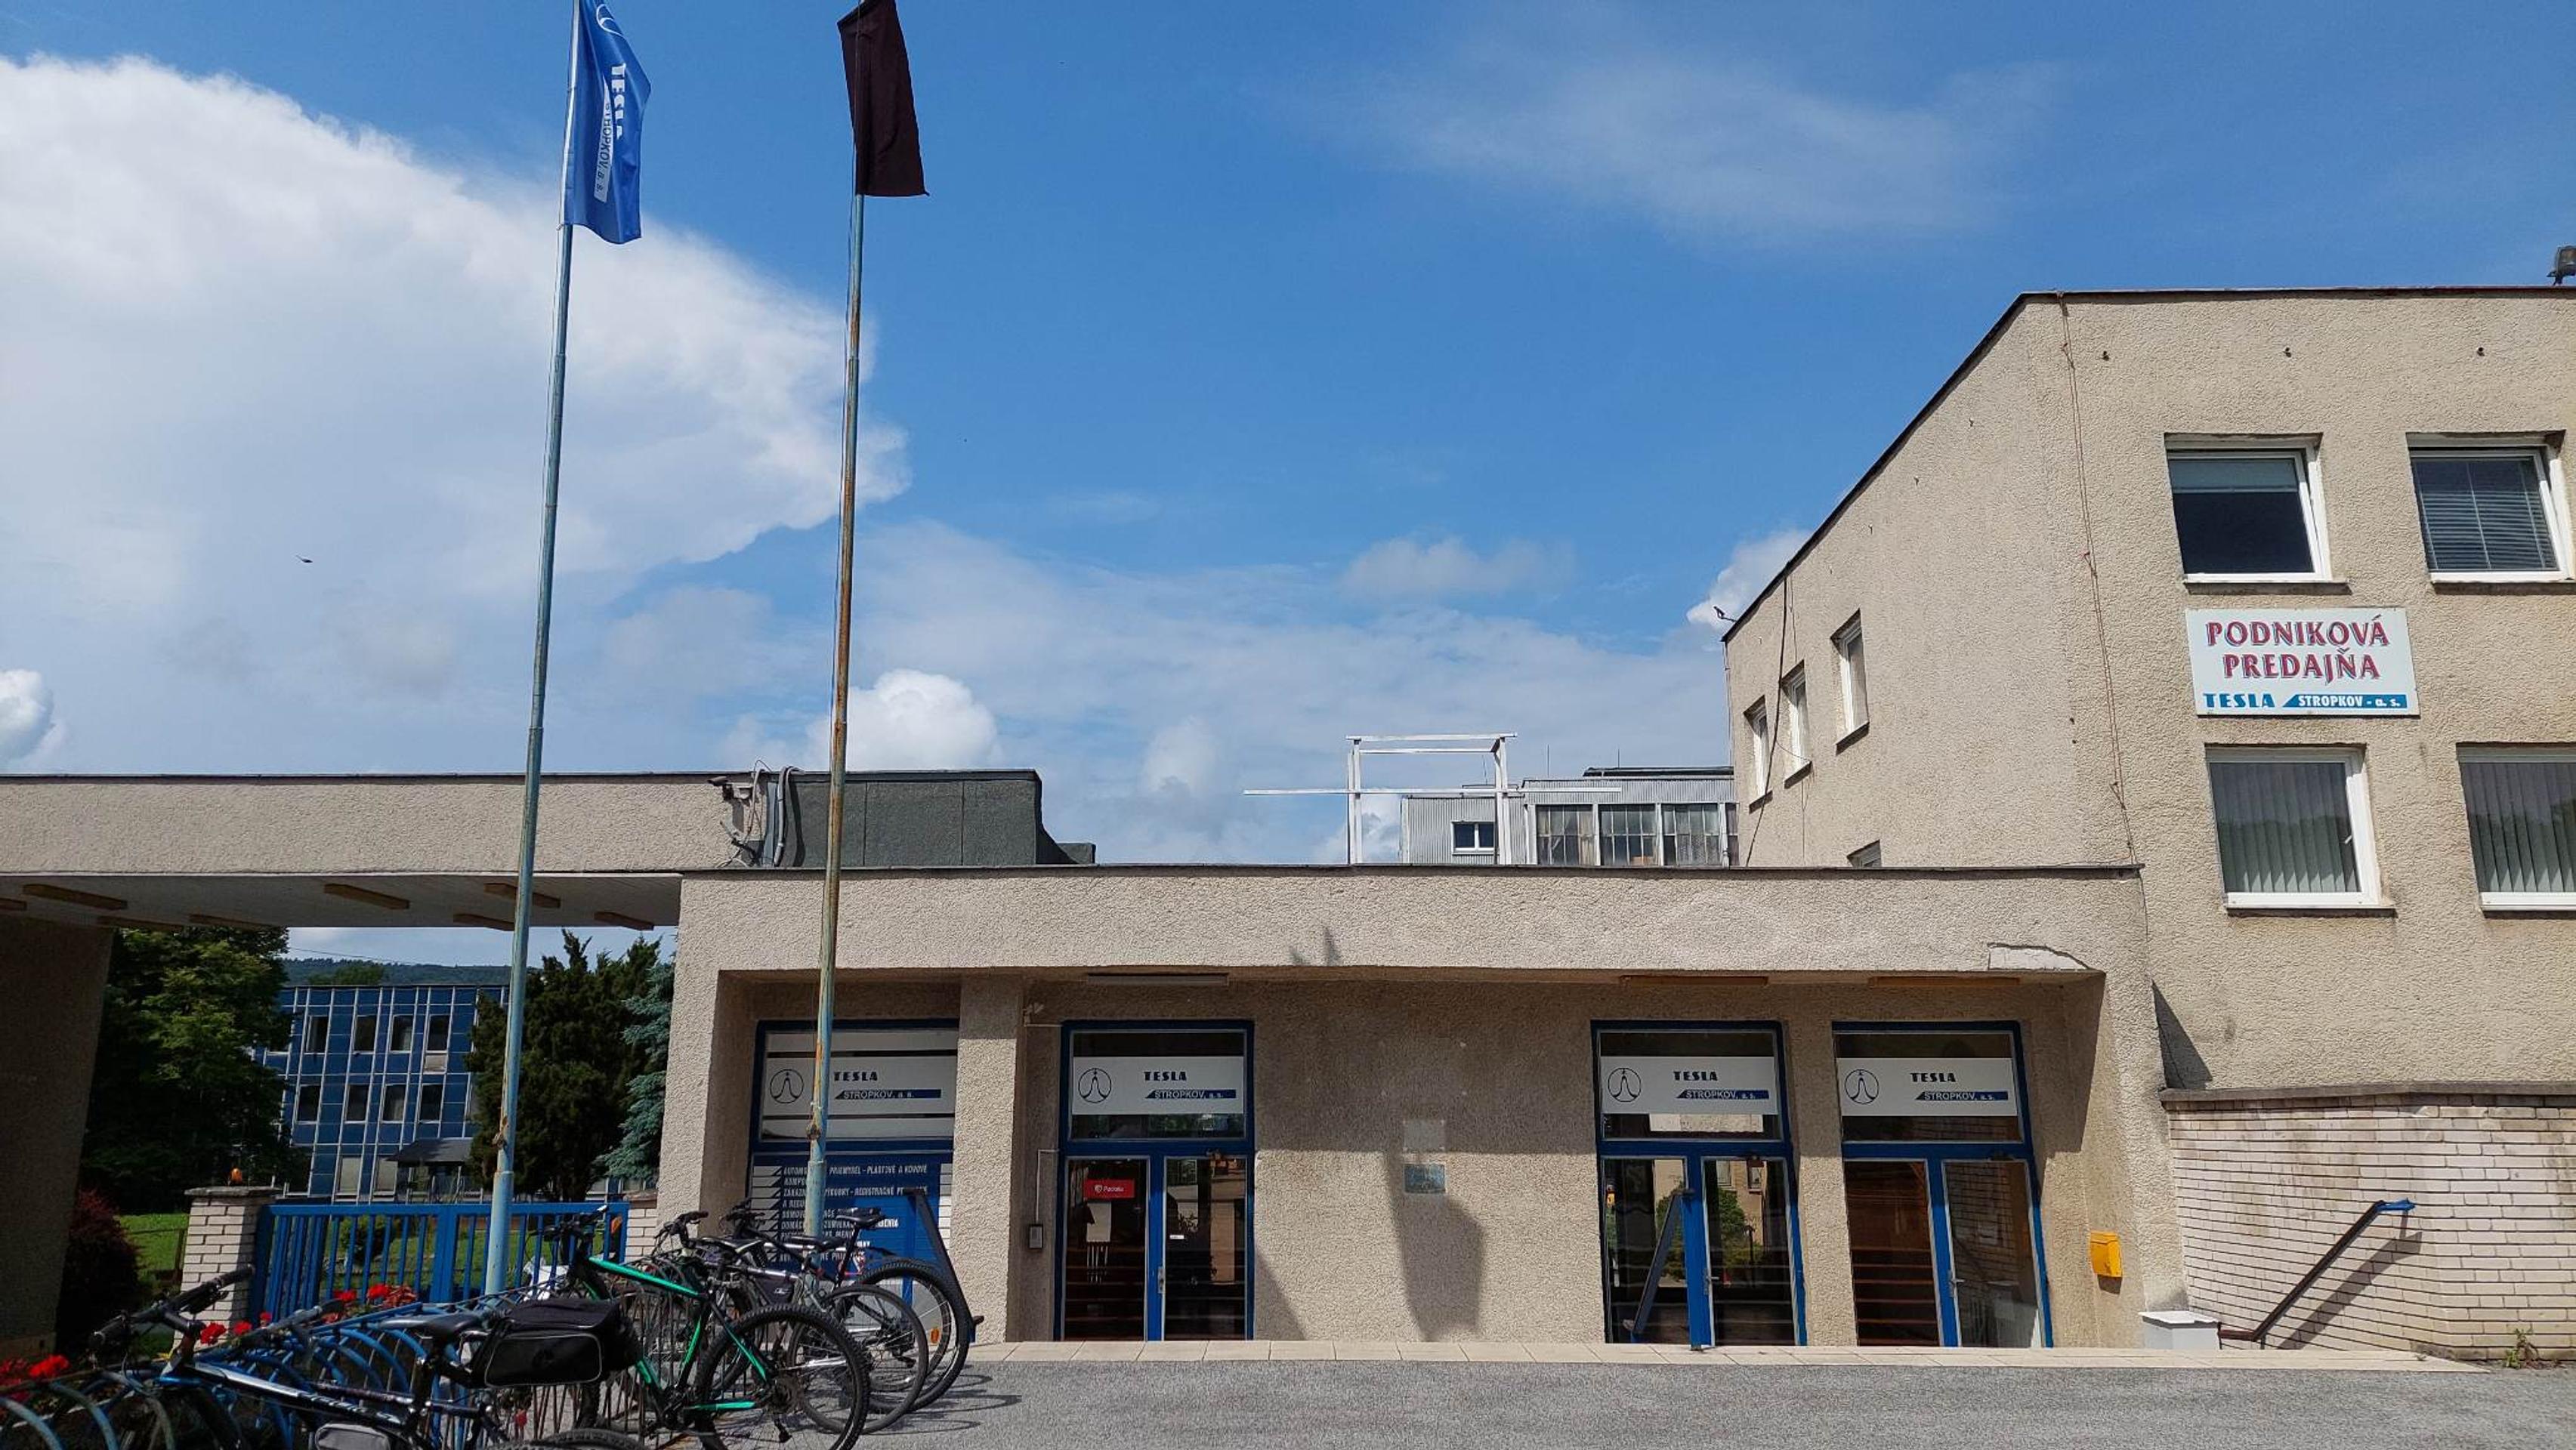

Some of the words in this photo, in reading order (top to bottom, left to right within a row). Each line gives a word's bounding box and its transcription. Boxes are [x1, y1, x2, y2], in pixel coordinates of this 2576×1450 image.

[2205, 614, 2390, 646] PODNIKOVÁ
[2222, 647, 2380, 686] PREDAJŇA
[2203, 693, 2275, 708] TESLA
[2298, 696, 2363, 707] STROPKOV
[834, 1072, 878, 1081] TESLA
[1144, 1072, 1188, 1081] TESLA
[1673, 1072, 1718, 1081] TESLA
[1910, 1072, 1956, 1082] TESLA
